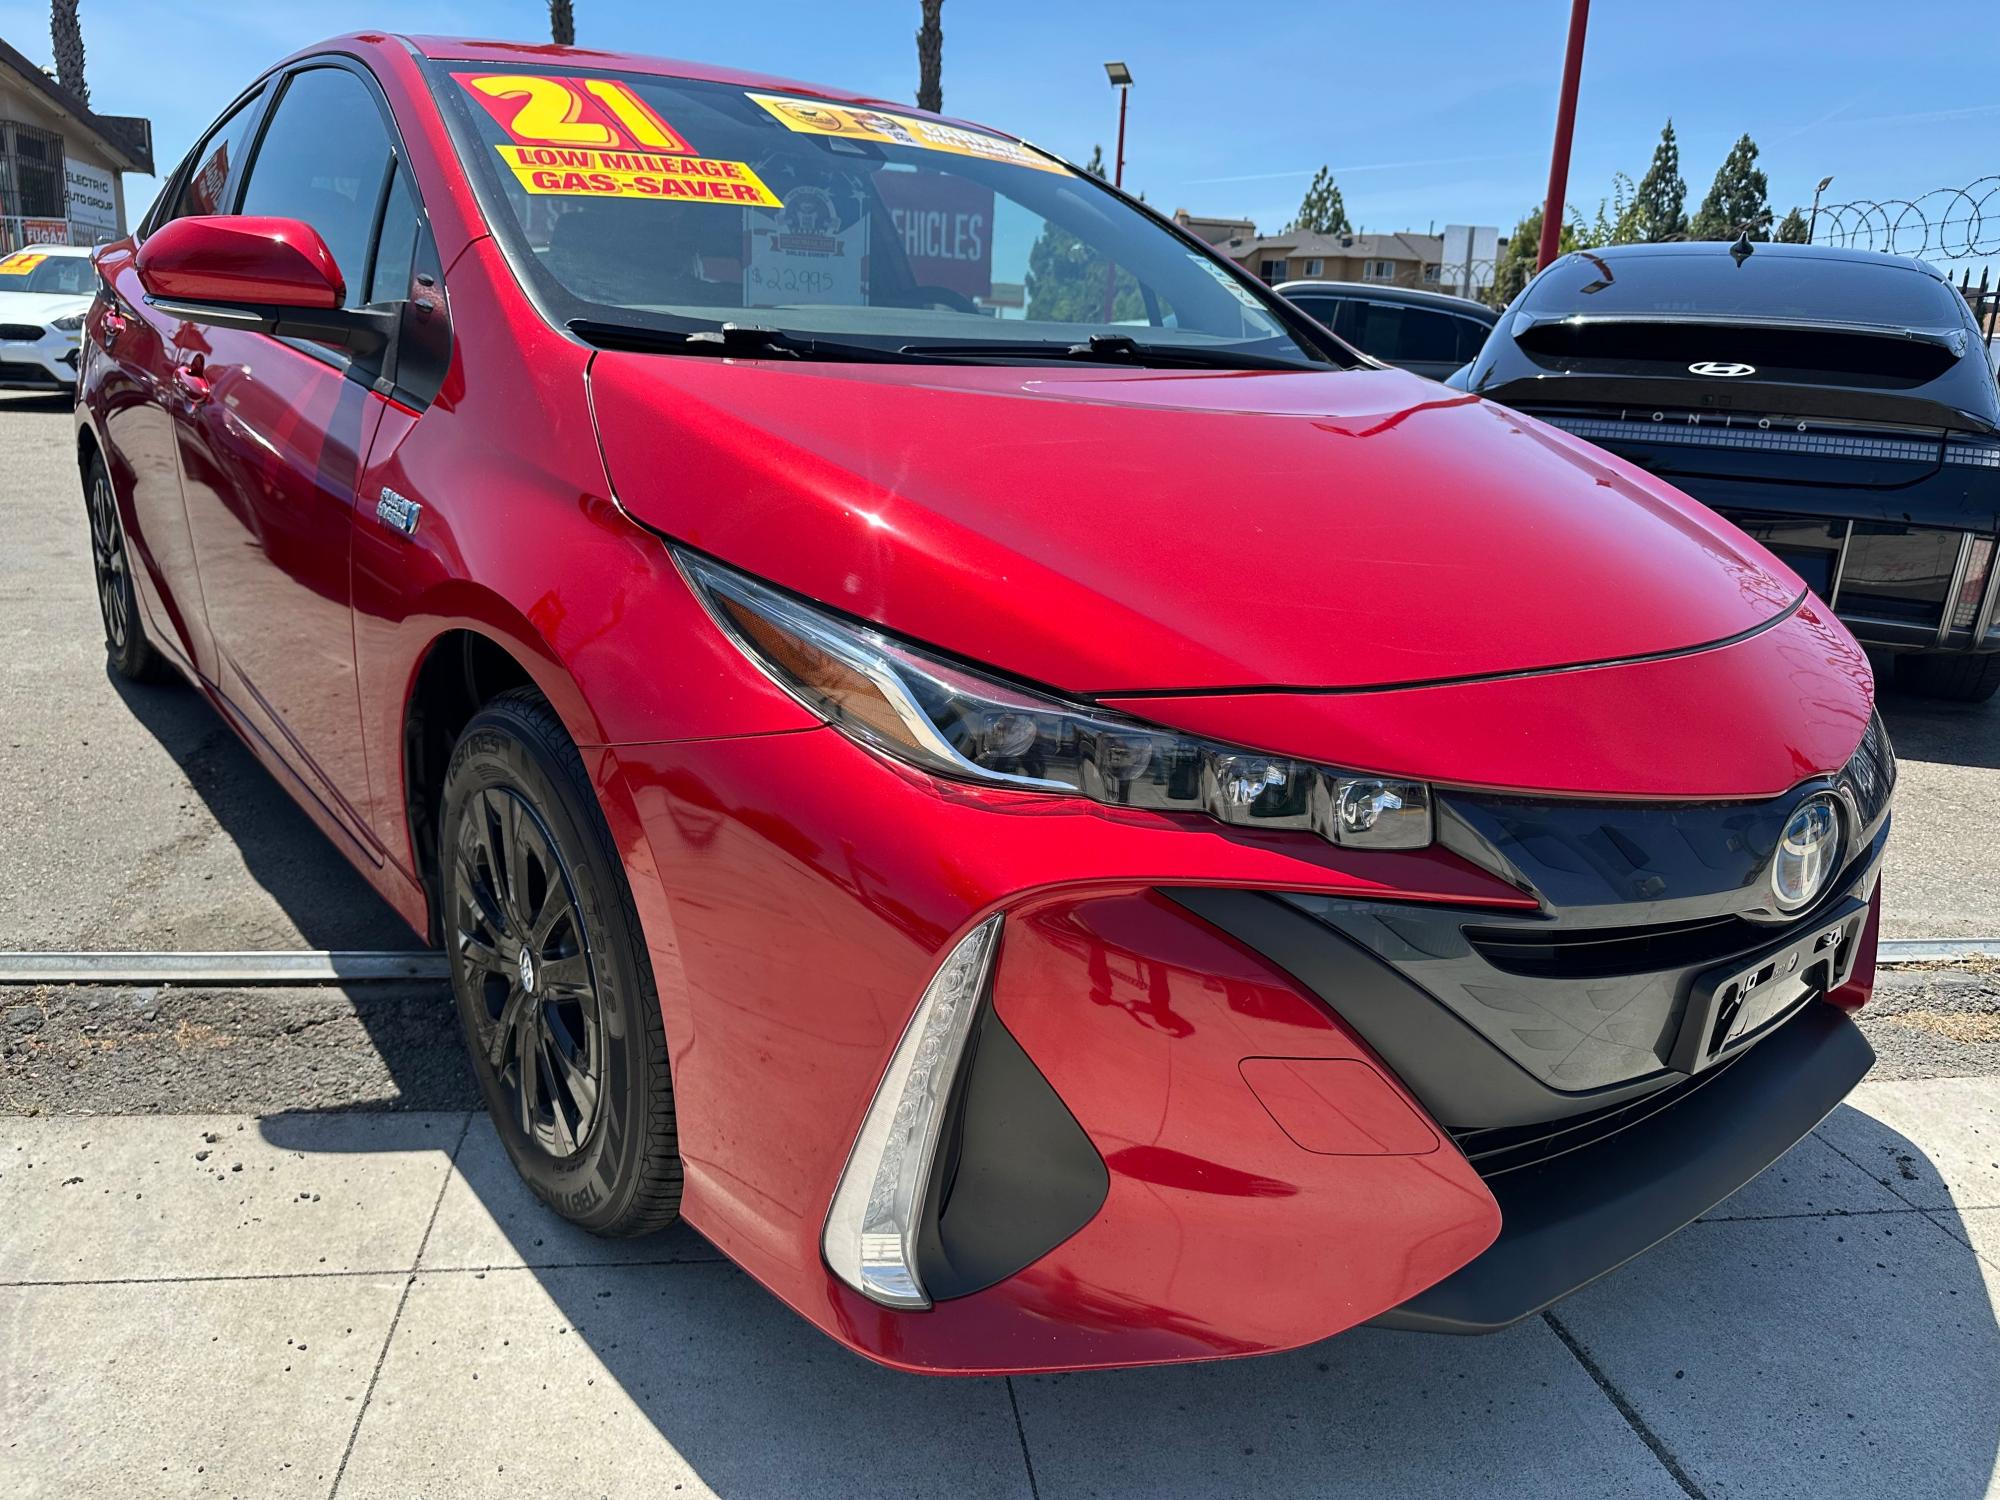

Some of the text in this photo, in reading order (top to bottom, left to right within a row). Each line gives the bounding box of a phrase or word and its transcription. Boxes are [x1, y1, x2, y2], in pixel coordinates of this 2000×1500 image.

[470, 75, 682, 150] 21
[518, 147, 746, 181] LOW MILEAGE
[87, 197, 113, 211] GROUP
[532, 171, 765, 204] GAS-SAVER
[891, 207, 984, 262] EHICLES
